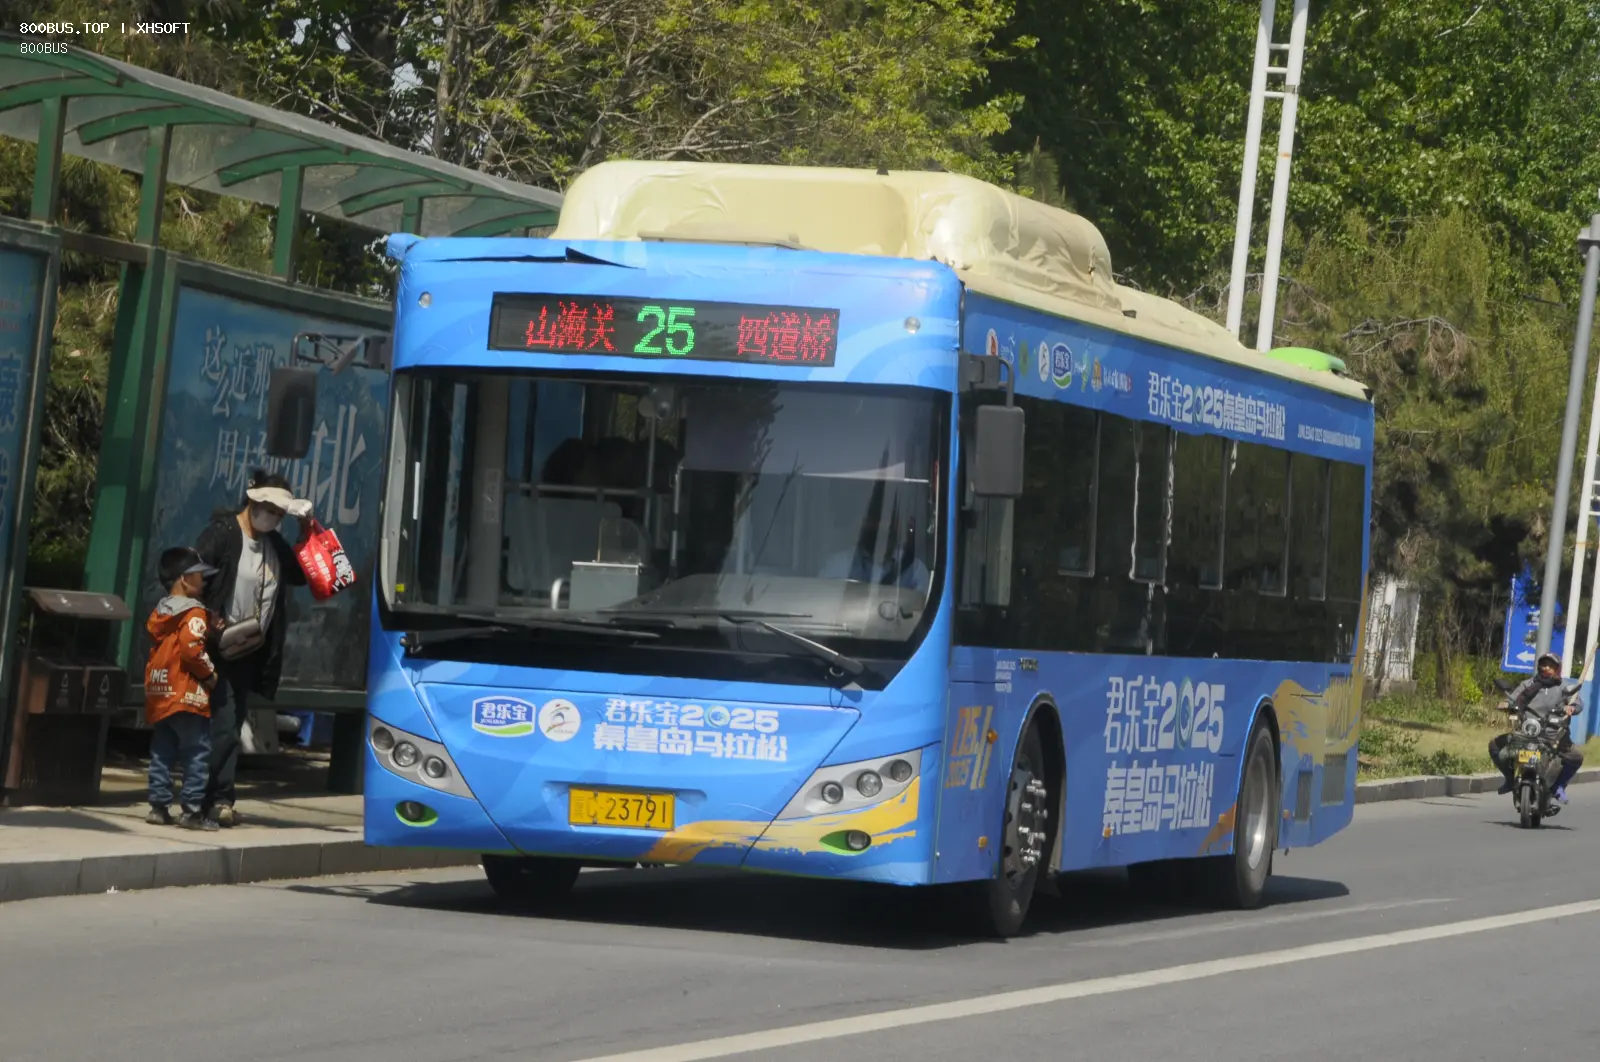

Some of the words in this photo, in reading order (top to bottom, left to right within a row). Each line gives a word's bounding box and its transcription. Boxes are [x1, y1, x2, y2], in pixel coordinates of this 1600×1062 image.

[526, 301, 619, 351] 山海关
[634, 305, 696, 356] 25
[736, 311, 836, 361] 四道桥
[480, 702, 528, 722] 君乐宝
[604, 697, 780, 734] 君乐宝2025
[1103, 674, 1226, 754] 君乐宝2025
[593, 721, 788, 763] 秦皇岛马拉松
[1102, 758, 1215, 838] 秦皇岛马拉松
